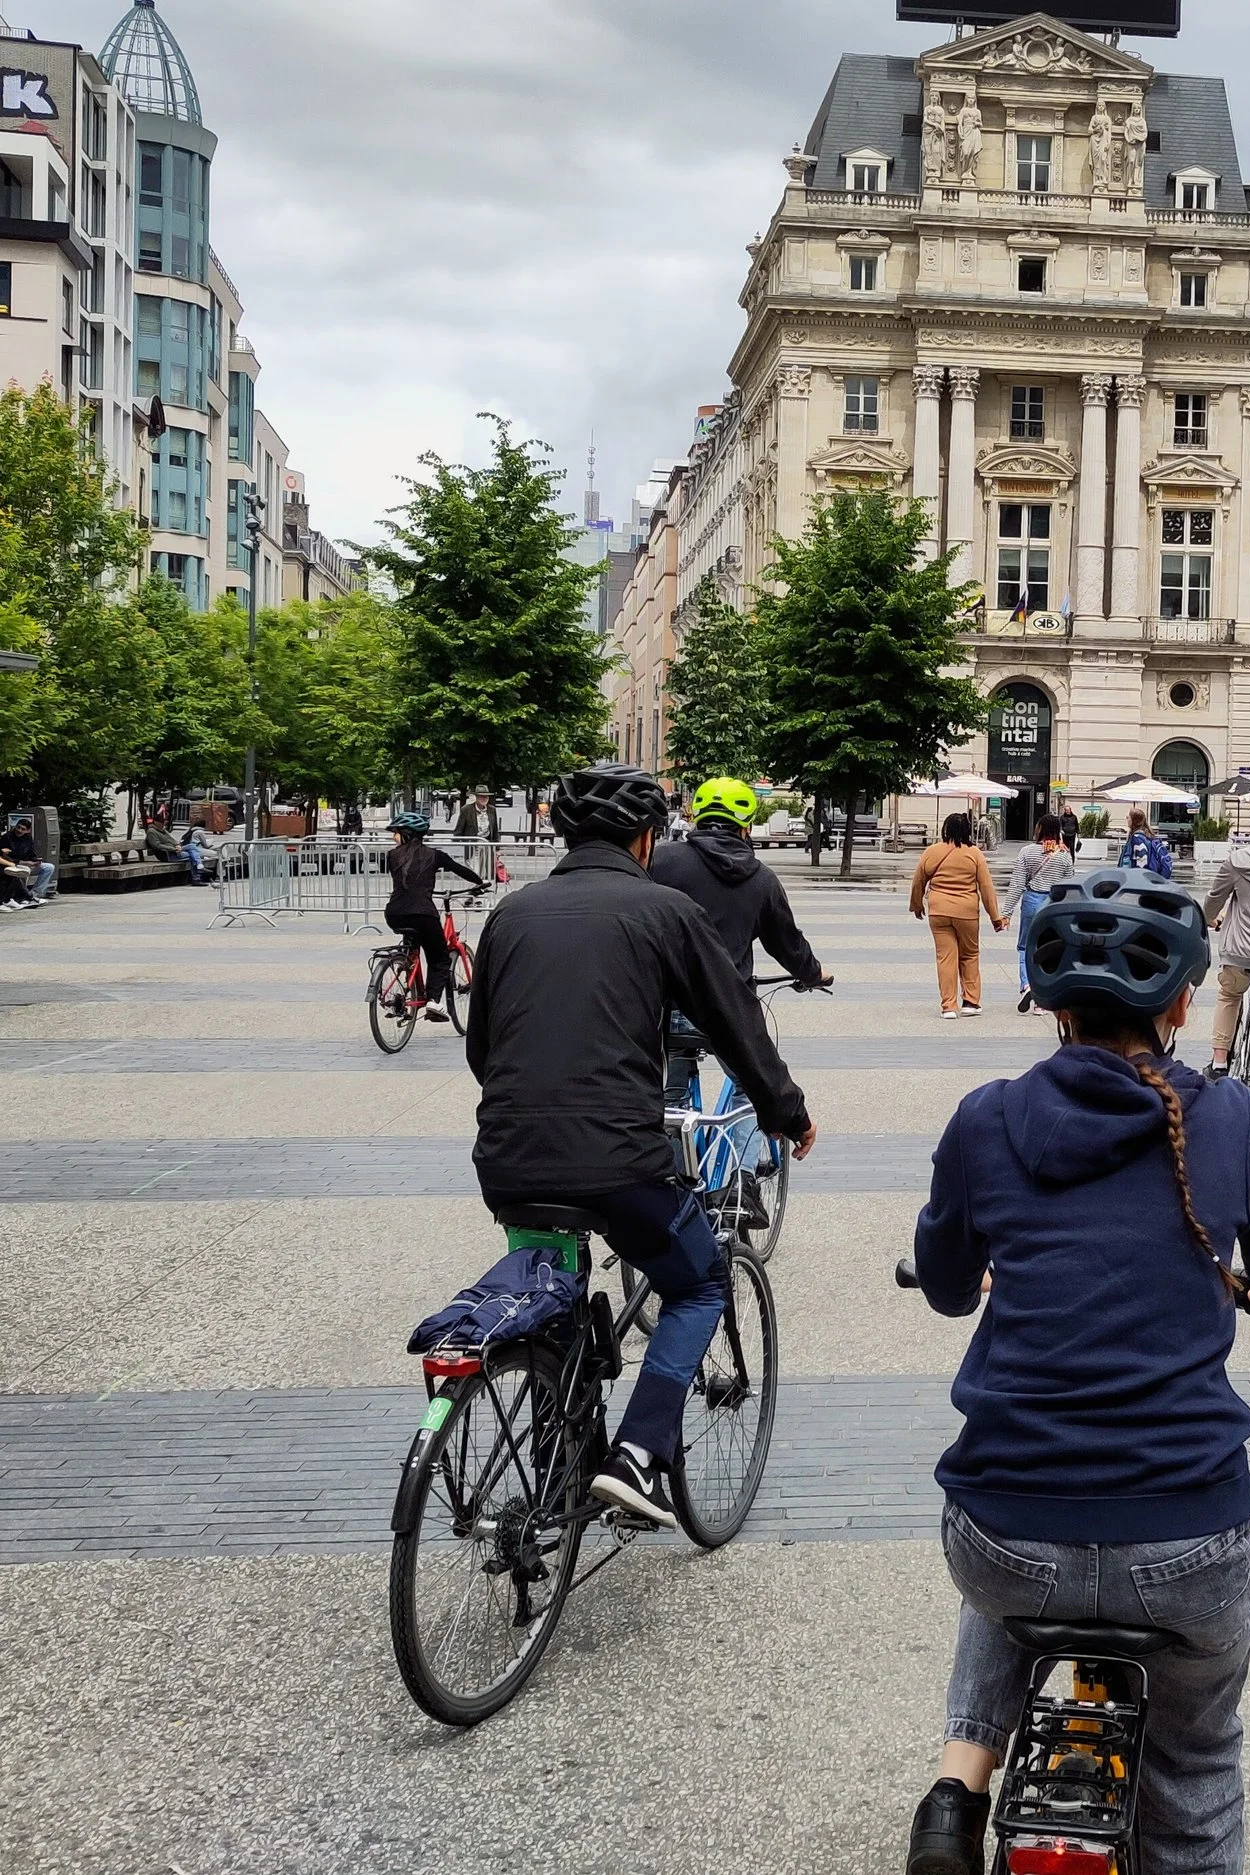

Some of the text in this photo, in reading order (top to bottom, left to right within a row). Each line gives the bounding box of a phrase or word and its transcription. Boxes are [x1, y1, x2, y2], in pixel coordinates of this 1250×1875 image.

[1, 70, 57, 117] K
[1001, 712, 1038, 729] tine
[1001, 728, 1038, 743] ntal
